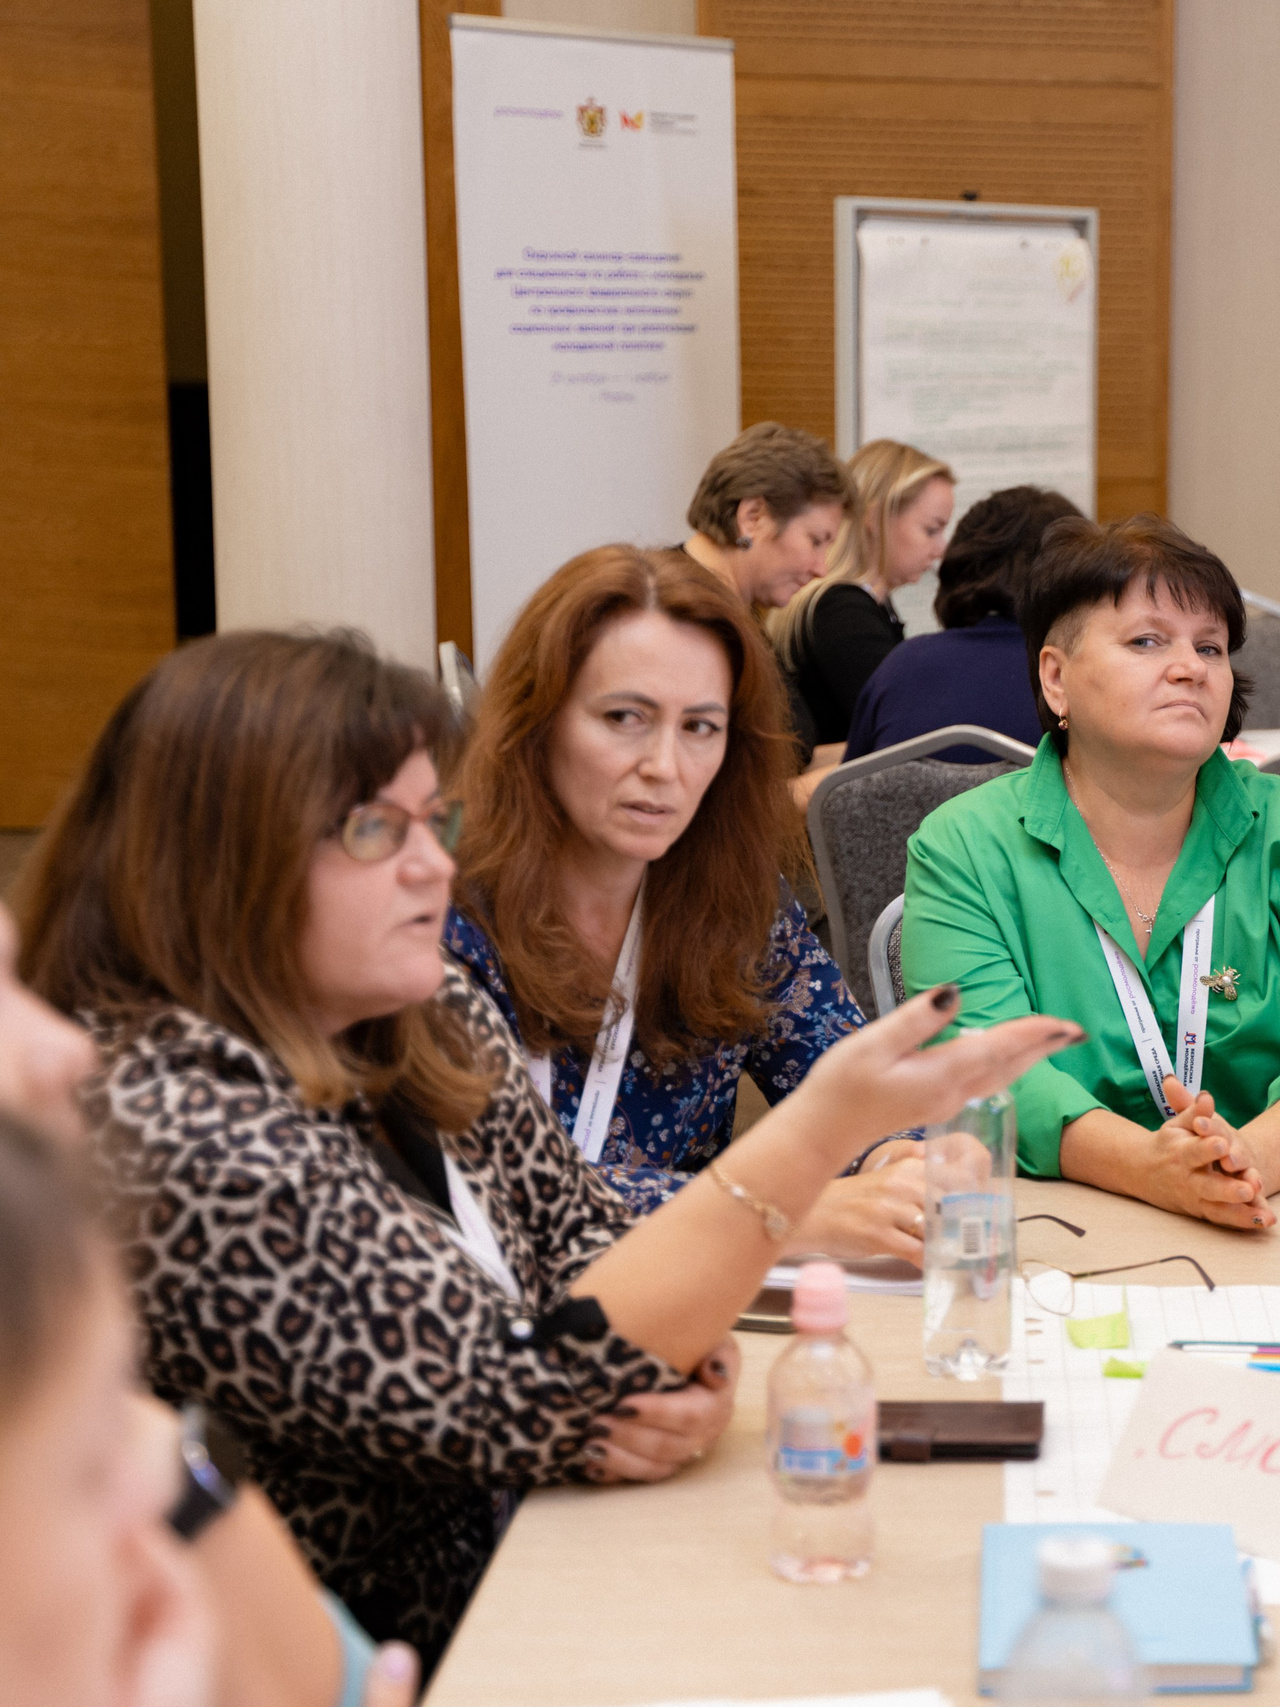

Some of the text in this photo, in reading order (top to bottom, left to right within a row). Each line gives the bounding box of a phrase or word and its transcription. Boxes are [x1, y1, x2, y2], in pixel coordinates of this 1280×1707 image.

[1115, 950, 1136, 999] росмолодёжь
[1191, 964, 1199, 1015] росмолодёжь
[1152, 1070, 1166, 1103] БЕЗОПАСНАЯ
